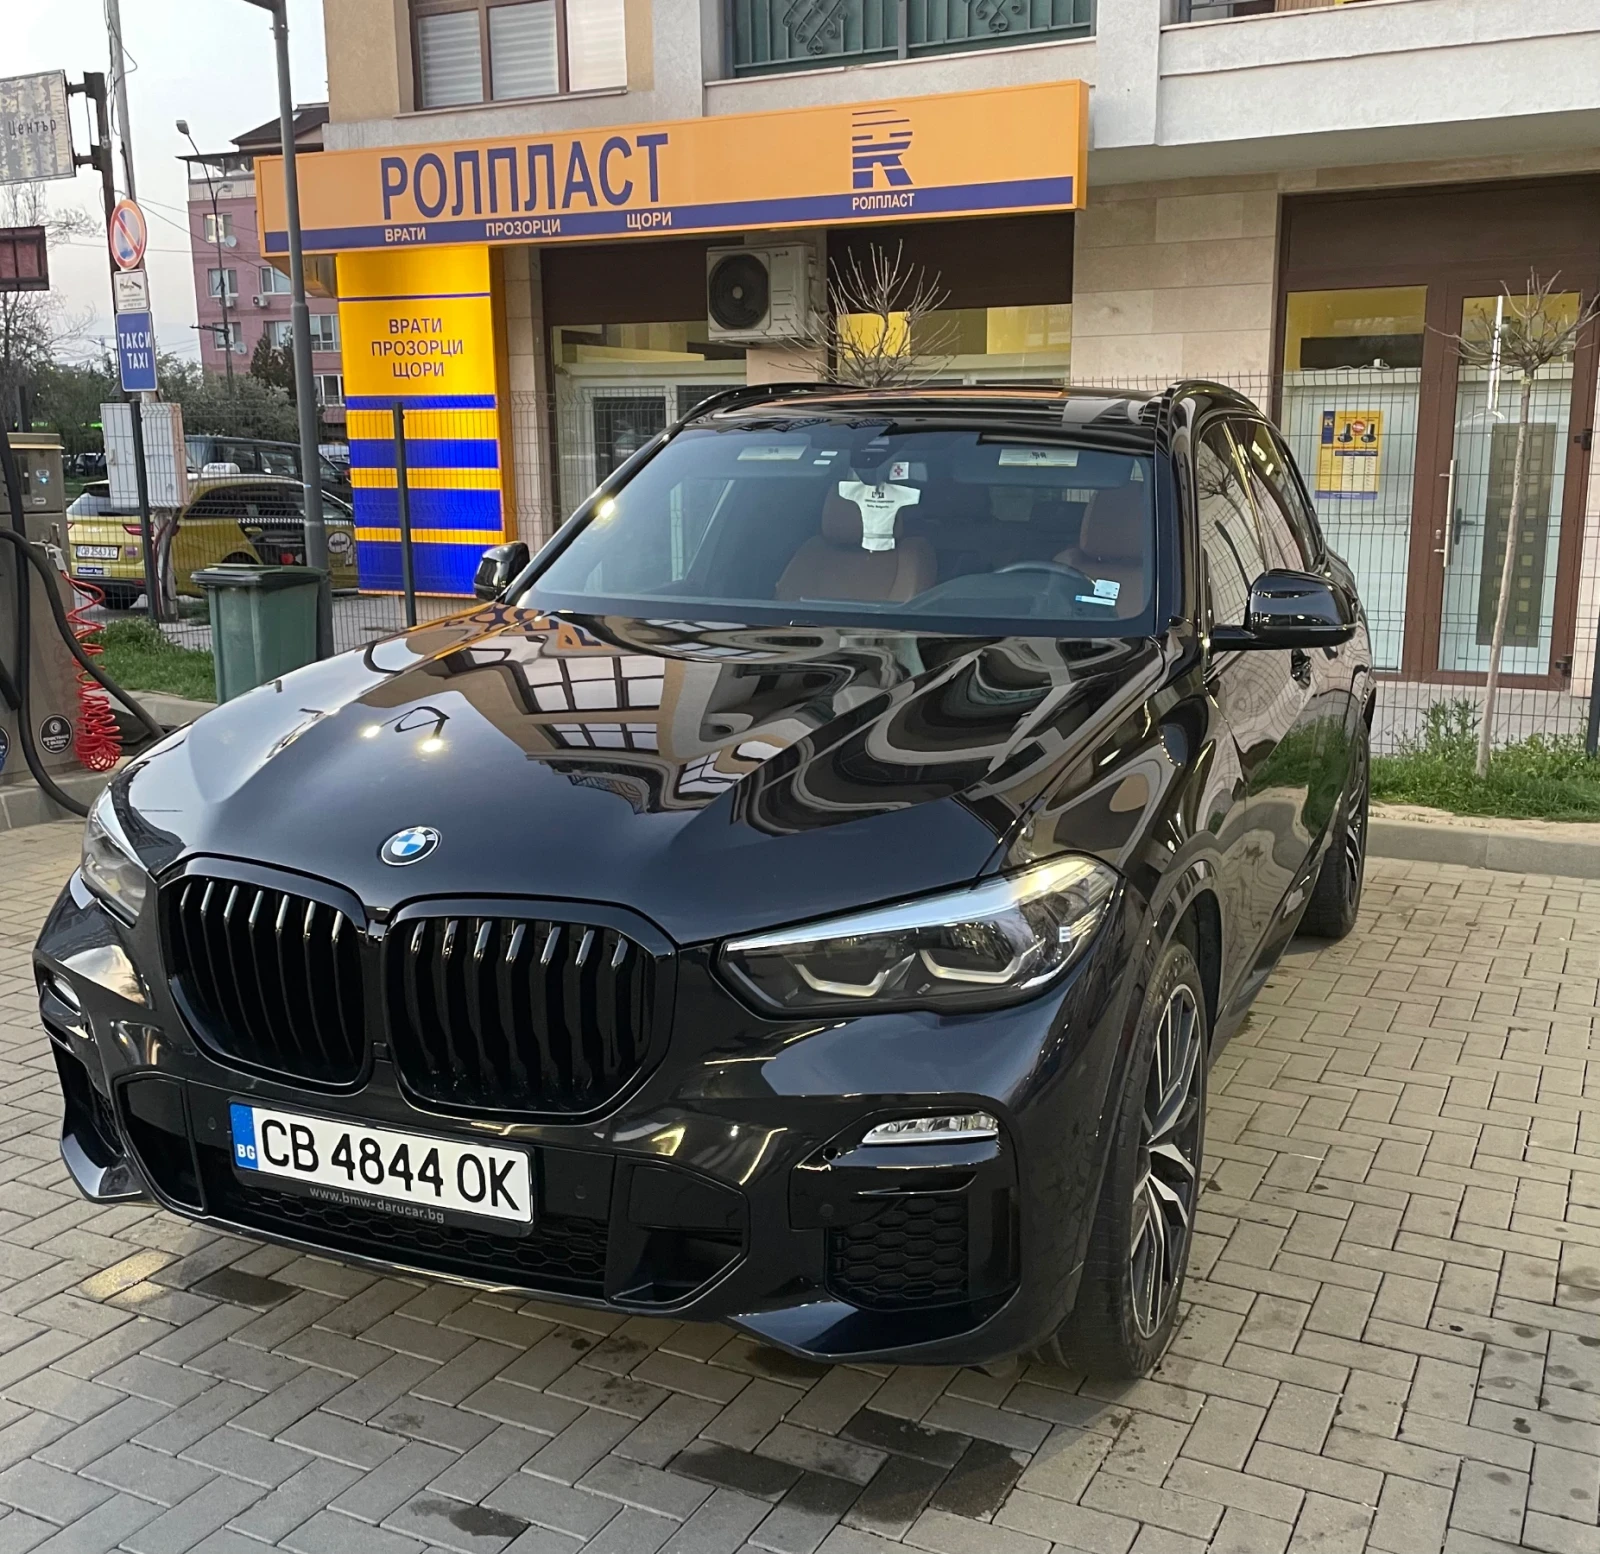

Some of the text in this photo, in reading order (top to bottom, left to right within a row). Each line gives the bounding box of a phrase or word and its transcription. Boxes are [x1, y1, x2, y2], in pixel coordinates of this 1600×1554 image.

[8, 119, 57, 138] Център
[380, 132, 669, 220] РОЛПЛАСТ
[852, 193, 915, 210] РОЛПЛАСТ
[384, 211, 673, 242] ВРАТИ ПРОЗОРЦИ ЩОРИ
[389, 317, 443, 334] ВРАТИ
[119, 331, 152, 350] ТАКСИ
[371, 339, 464, 357] ПРОЗОРЦИ
[126, 352, 149, 370] TAXI
[392, 361, 445, 380] ЩОРИ
[237, 1143, 256, 1161] BG
[261, 1119, 520, 1212] CB 4844 OK
[309, 1187, 445, 1224] www.bmw-darucar.bg
